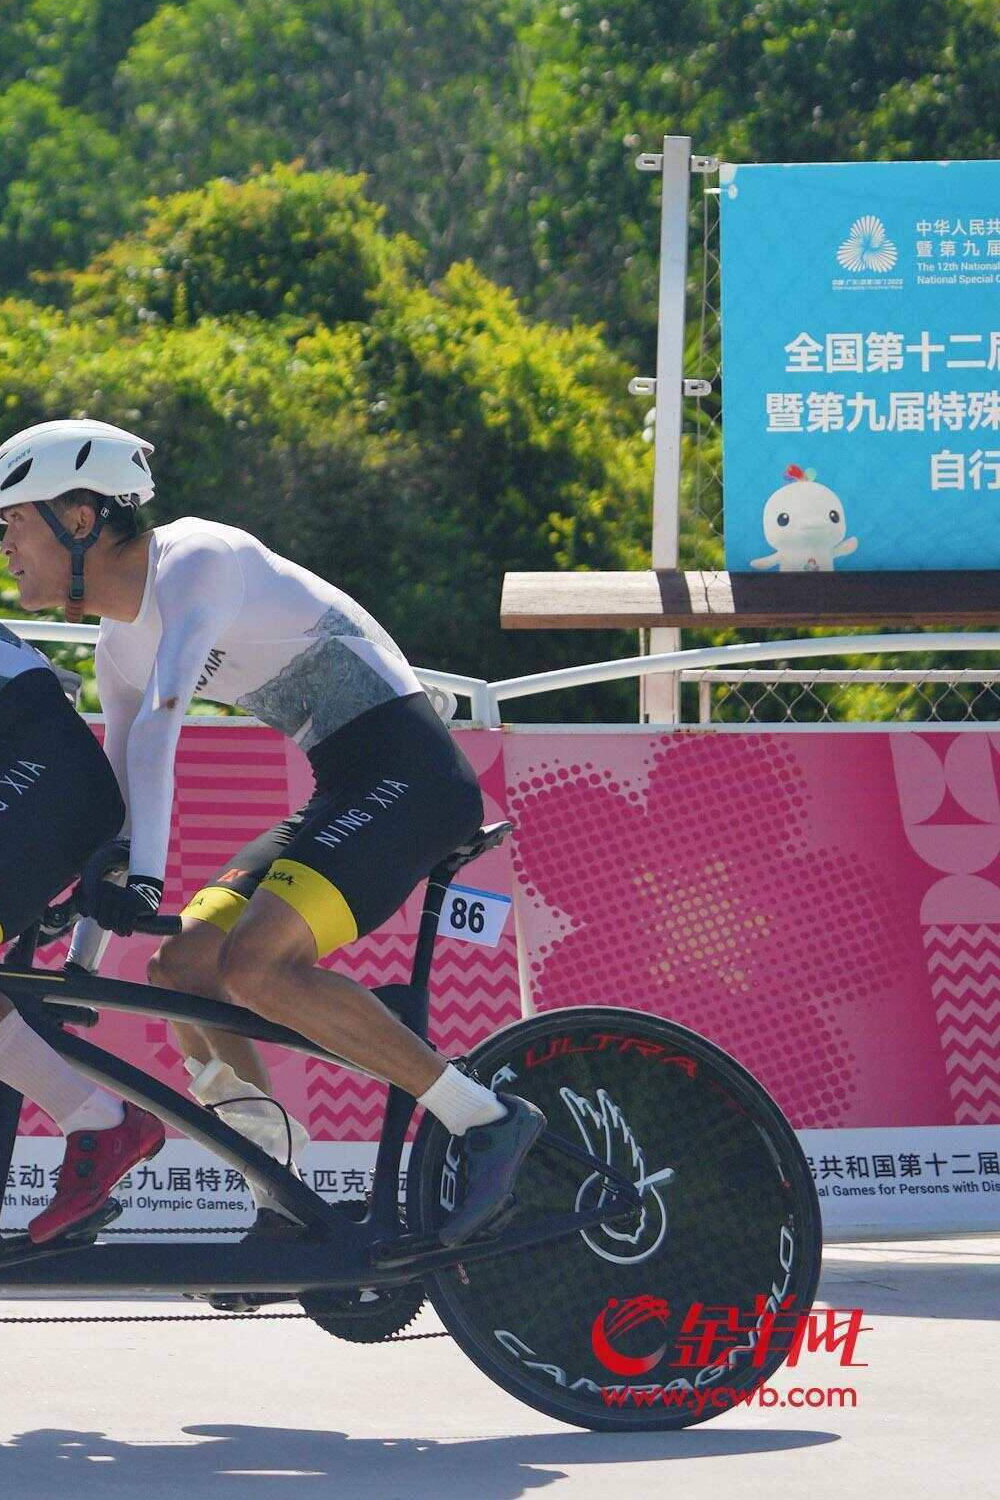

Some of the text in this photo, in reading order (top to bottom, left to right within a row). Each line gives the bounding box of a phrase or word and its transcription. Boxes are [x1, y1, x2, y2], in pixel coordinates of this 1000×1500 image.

[917, 263, 935, 271] The
[939, 263, 959, 271] 12th
[917, 275, 956, 284] National
[959, 275, 994, 286] Special
[0, 760, 46, 796] XIA
[314, 779, 409, 848] NING XIA
[450, 897, 486, 933] 86
[833, 1185, 875, 1196] Games
[879, 1184, 896, 1195] for
[900, 1183, 949, 1195] Persons
[953, 1181, 978, 1193] with
[137, 1197, 192, 1211] Olympic
[197, 1198, 247, 1211] Games,
